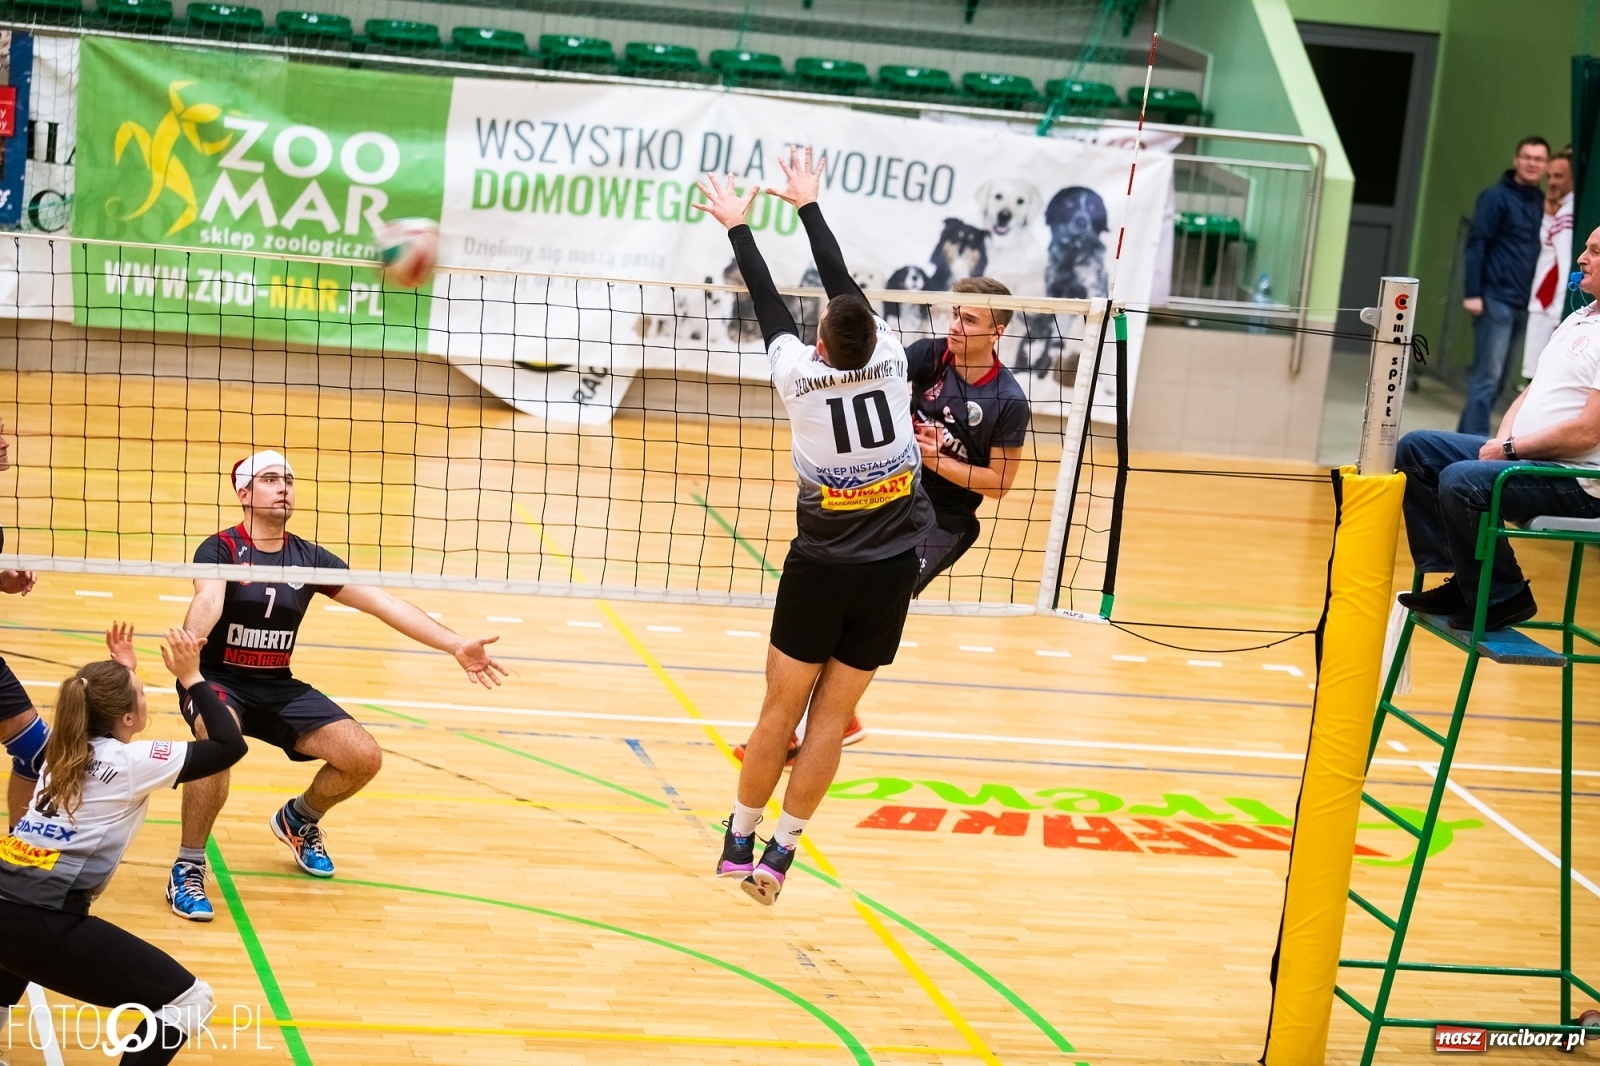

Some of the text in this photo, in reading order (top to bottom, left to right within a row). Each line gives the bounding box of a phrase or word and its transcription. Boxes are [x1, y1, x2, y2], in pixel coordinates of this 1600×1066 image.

[217, 116, 401, 184] ZOO
[476, 117, 683, 171] WSZYSTKO
[699, 131, 766, 180] DLA
[200, 169, 390, 236] MAR
[471, 168, 799, 237] DOMOWEGO OO
[199, 226, 255, 250] sklep
[463, 236, 533, 262] Dzielimy
[104, 259, 385, 317] WWW.ZOO-MAR.PL
[794, 374, 836, 398] JEDYNKA
[825, 389, 896, 454] 10
[265, 587, 276, 618] 7
